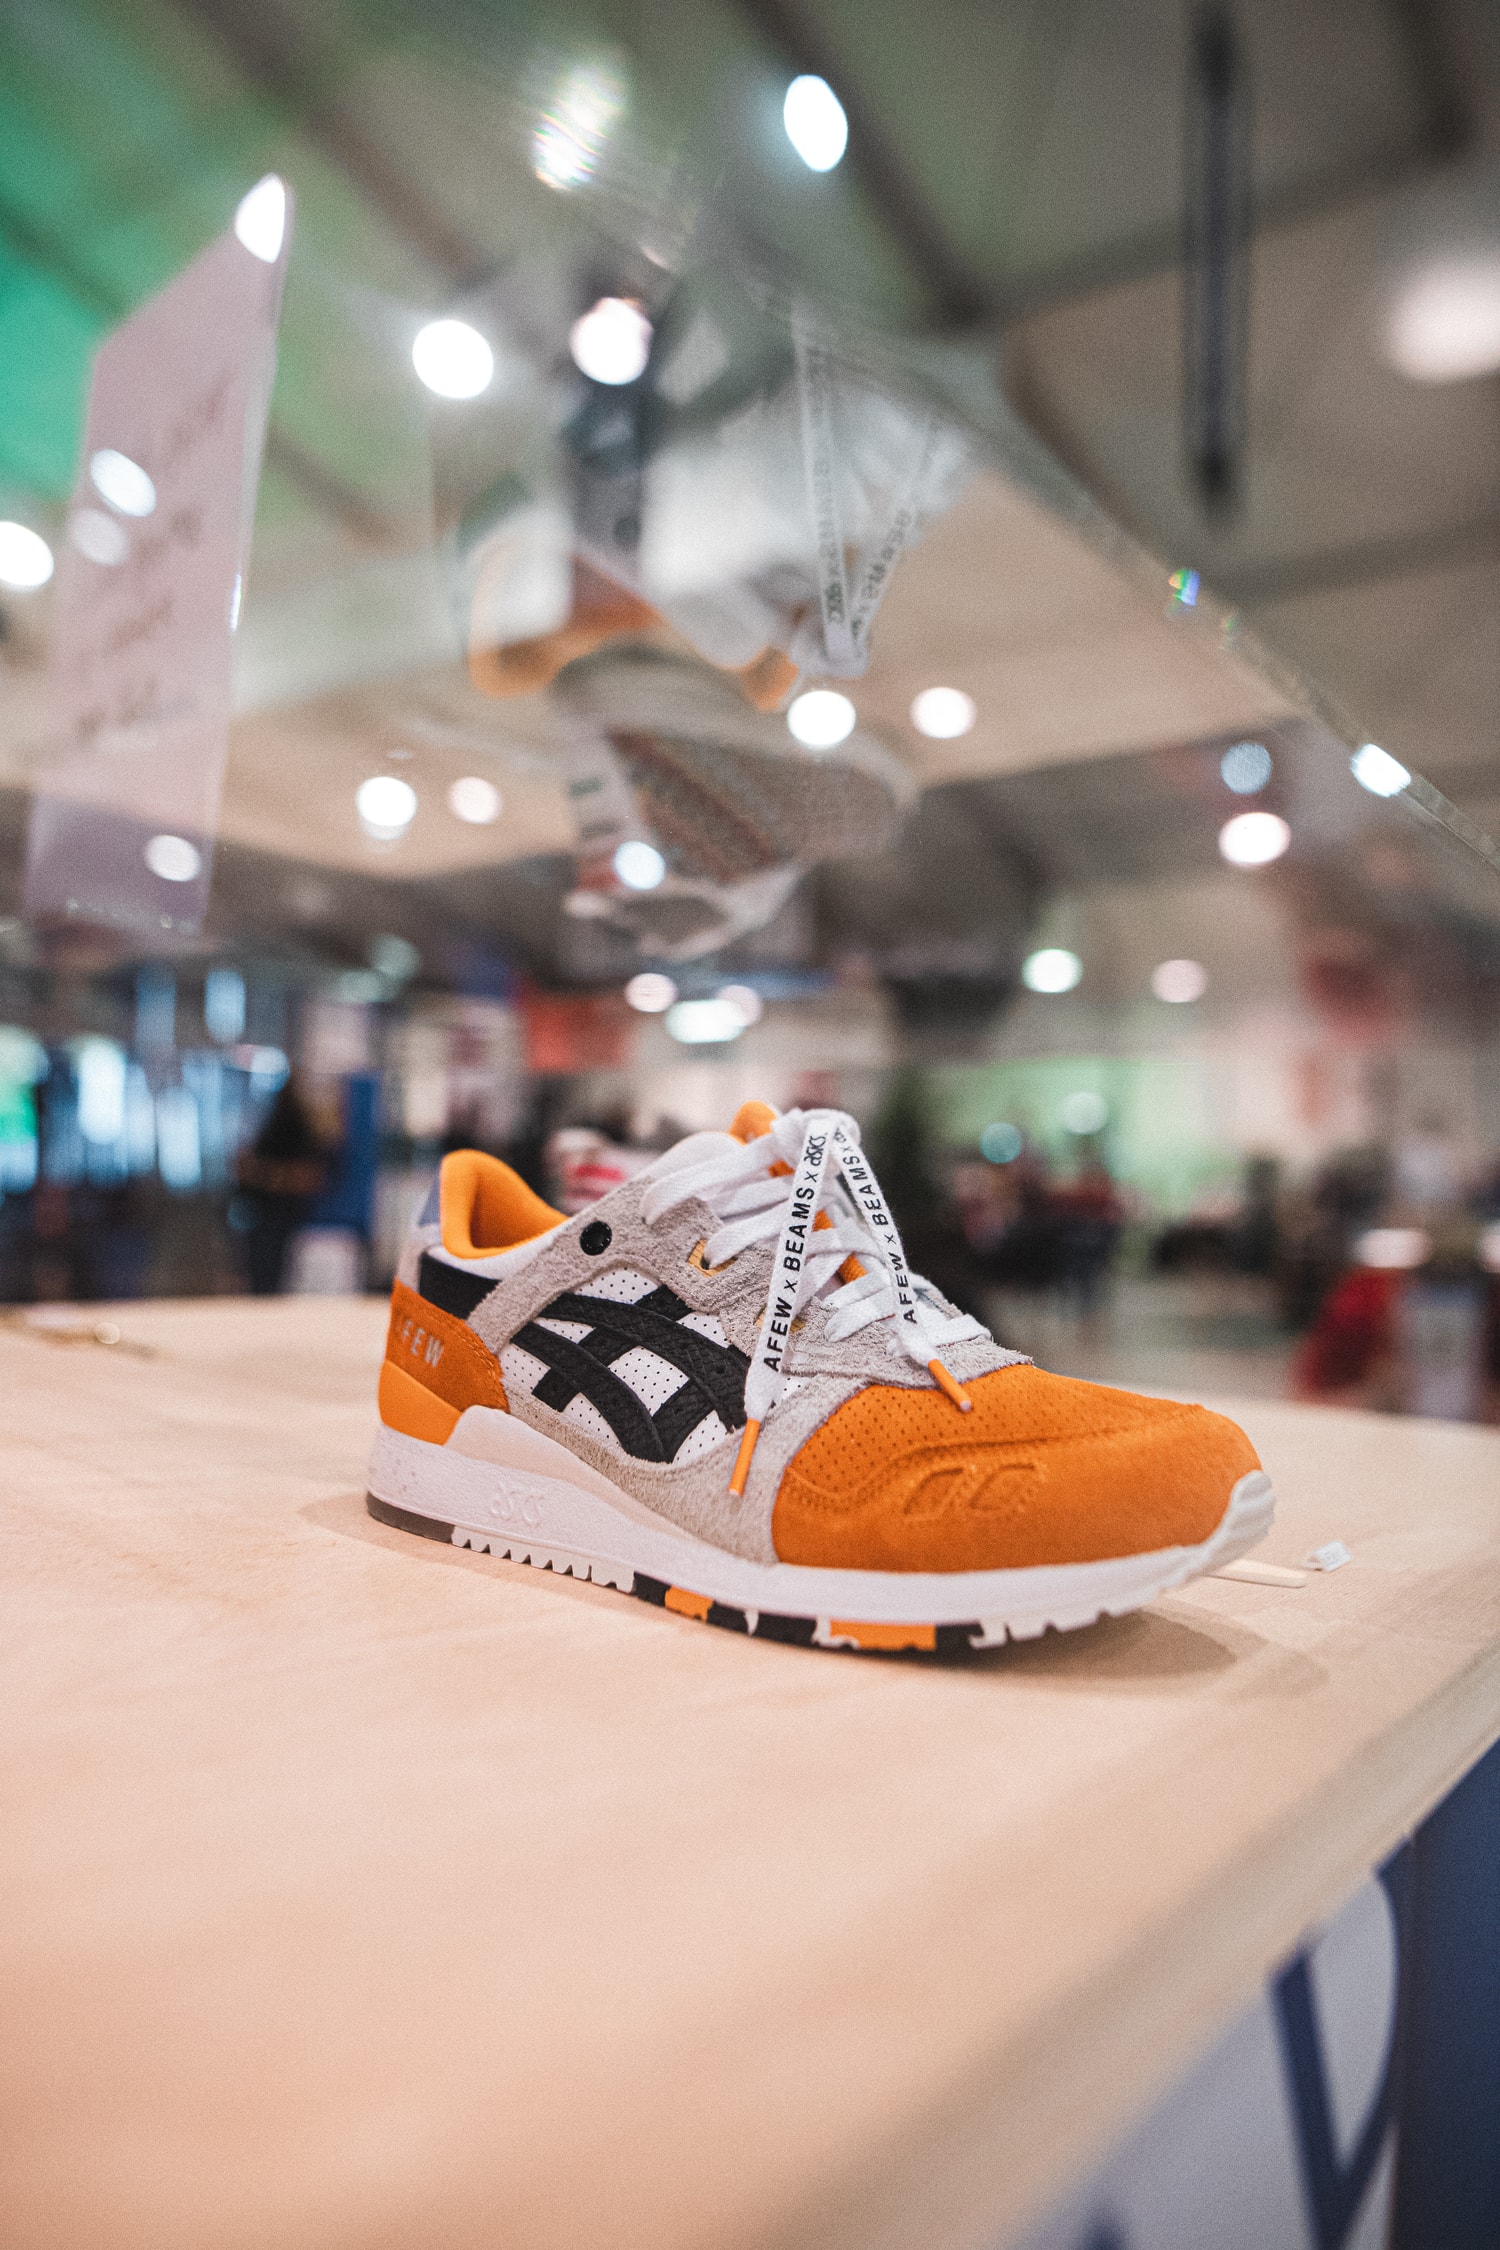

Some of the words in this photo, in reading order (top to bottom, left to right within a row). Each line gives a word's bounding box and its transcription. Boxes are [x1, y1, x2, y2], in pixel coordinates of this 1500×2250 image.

[843, 1155, 889, 1226] BEAMS
[763, 1296, 793, 1373] AFEW
[783, 1187, 815, 1272] BEAMS
[888, 1252, 917, 1324] AFEW
[400, 1318, 446, 1368] FEW
